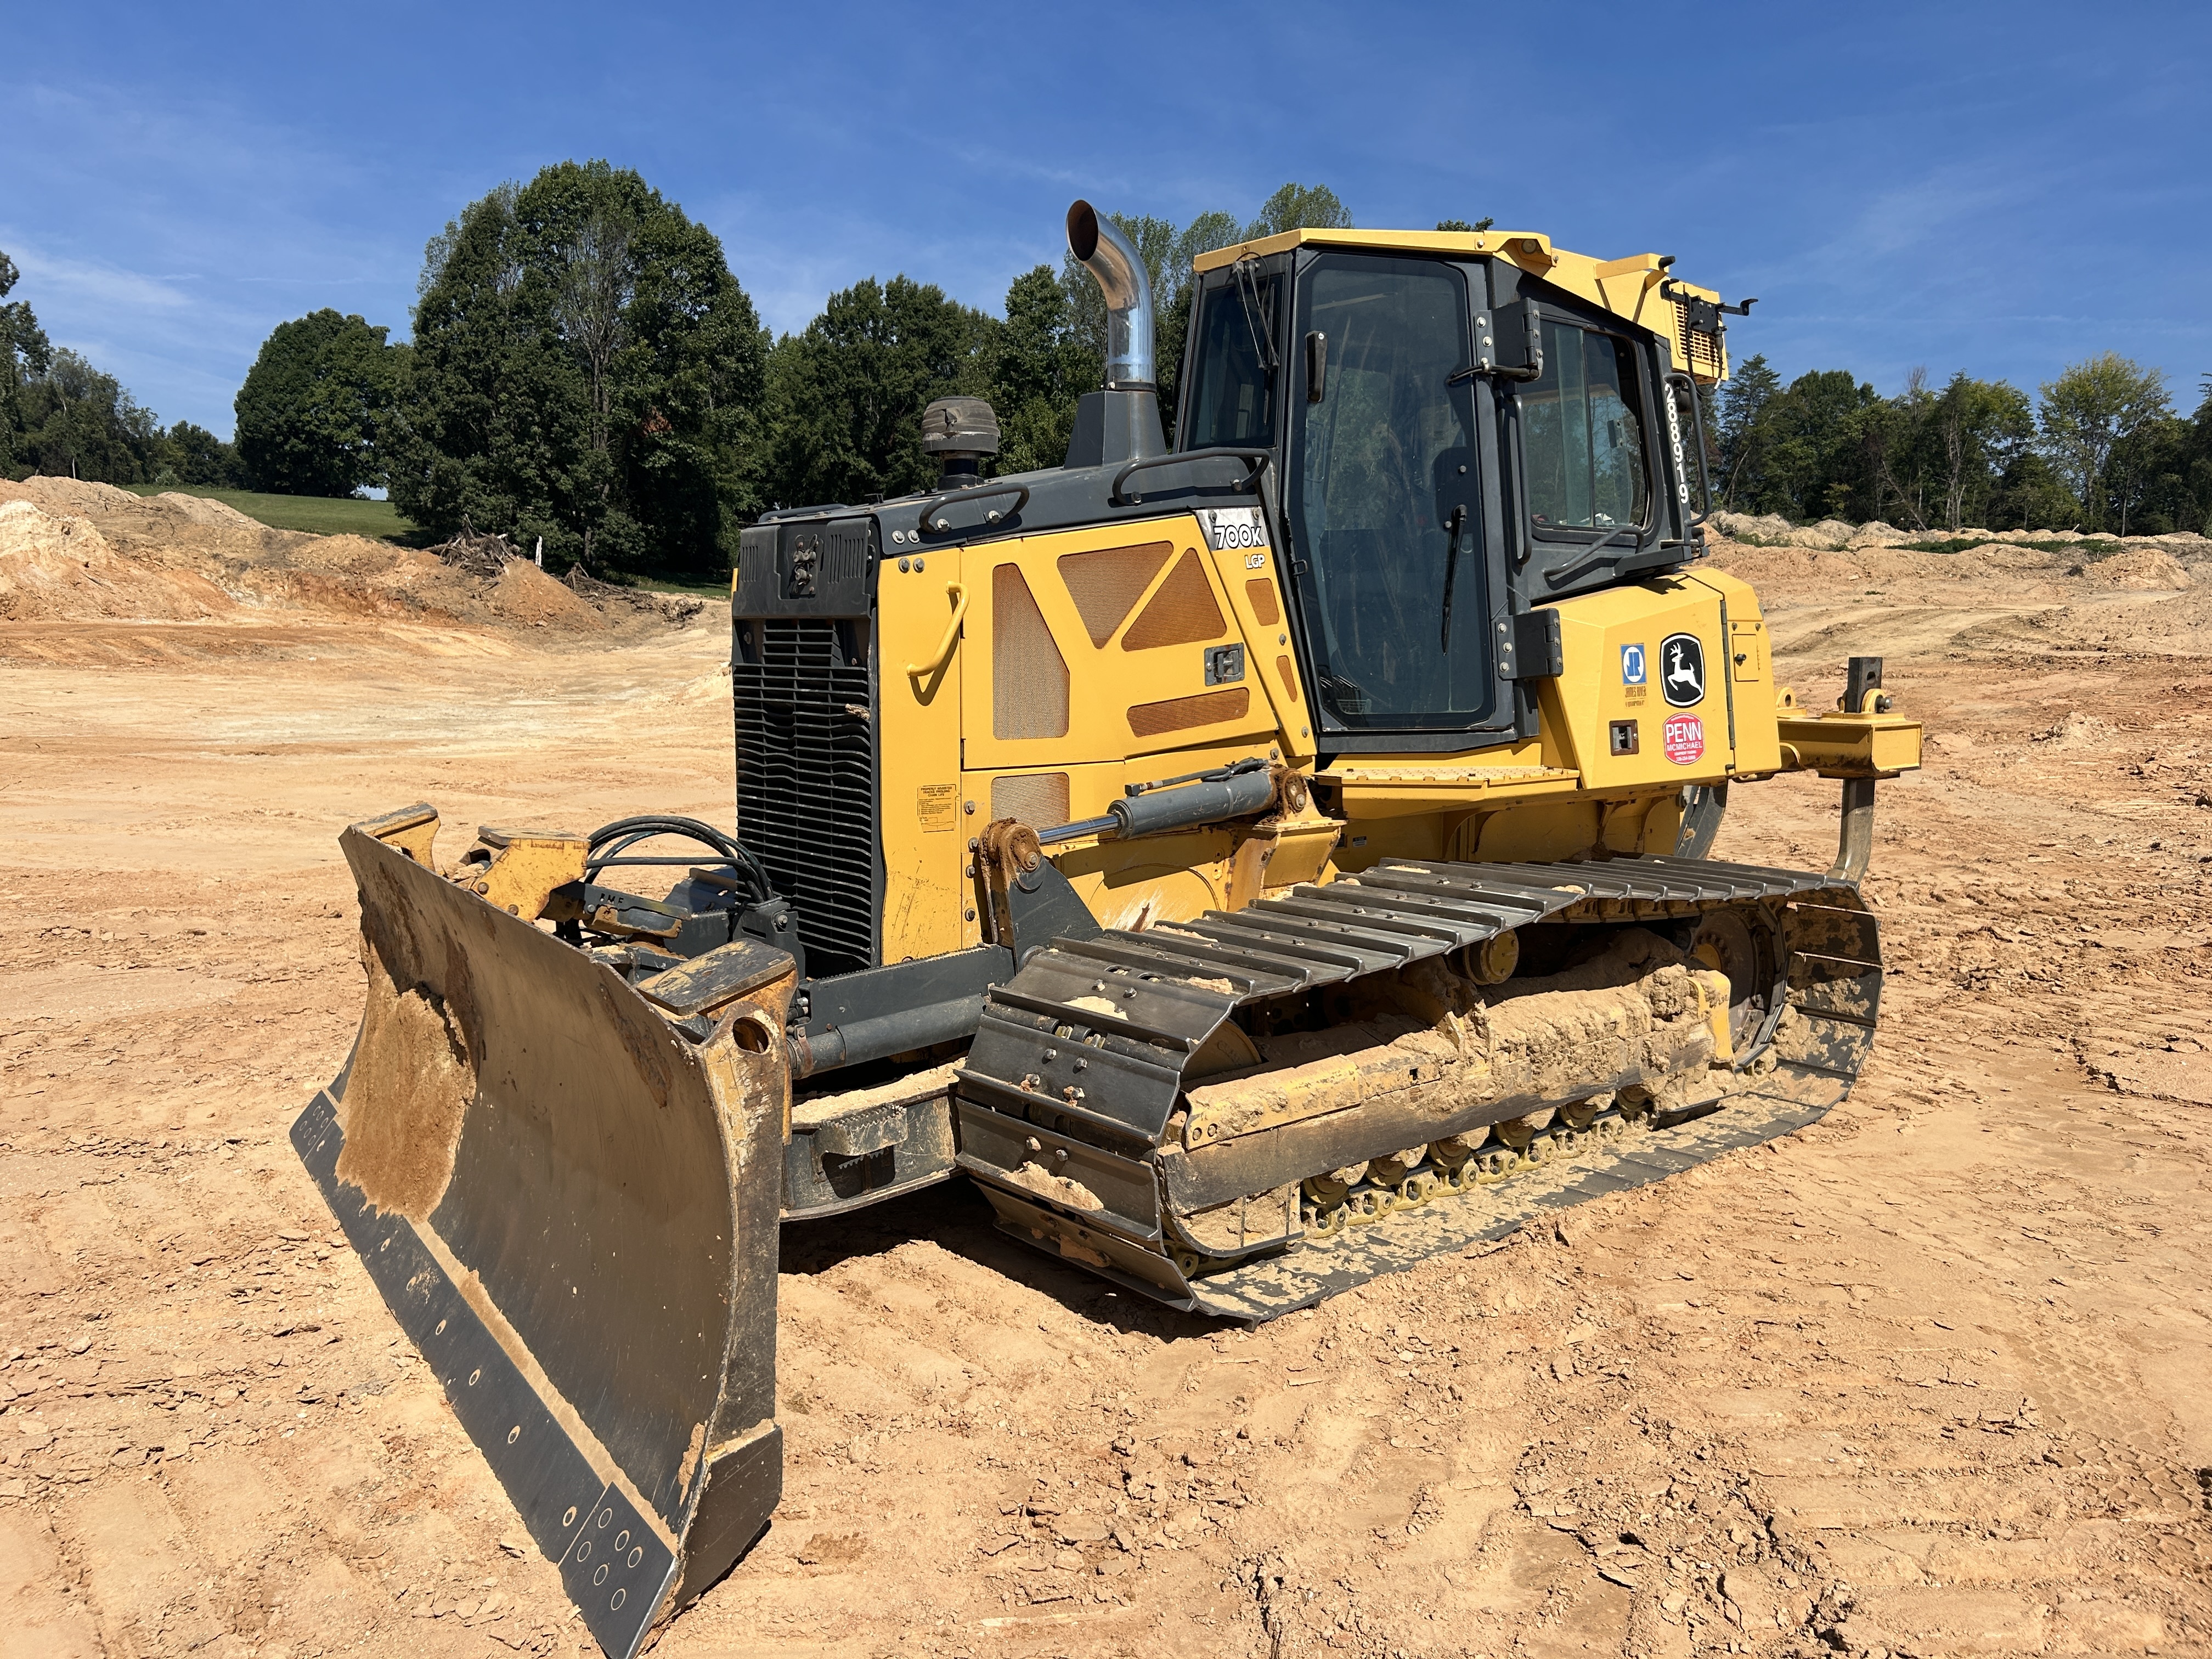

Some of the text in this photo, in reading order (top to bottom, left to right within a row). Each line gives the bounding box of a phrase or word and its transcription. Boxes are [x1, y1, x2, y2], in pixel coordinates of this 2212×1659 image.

[1665, 383, 1689, 504] 288919
[1213, 524, 1265, 550] 700K
[1244, 553, 1265, 569] LGP
[1666, 721, 1702, 743] PENN
[1667, 741, 1703, 752] MCMICHAEL
